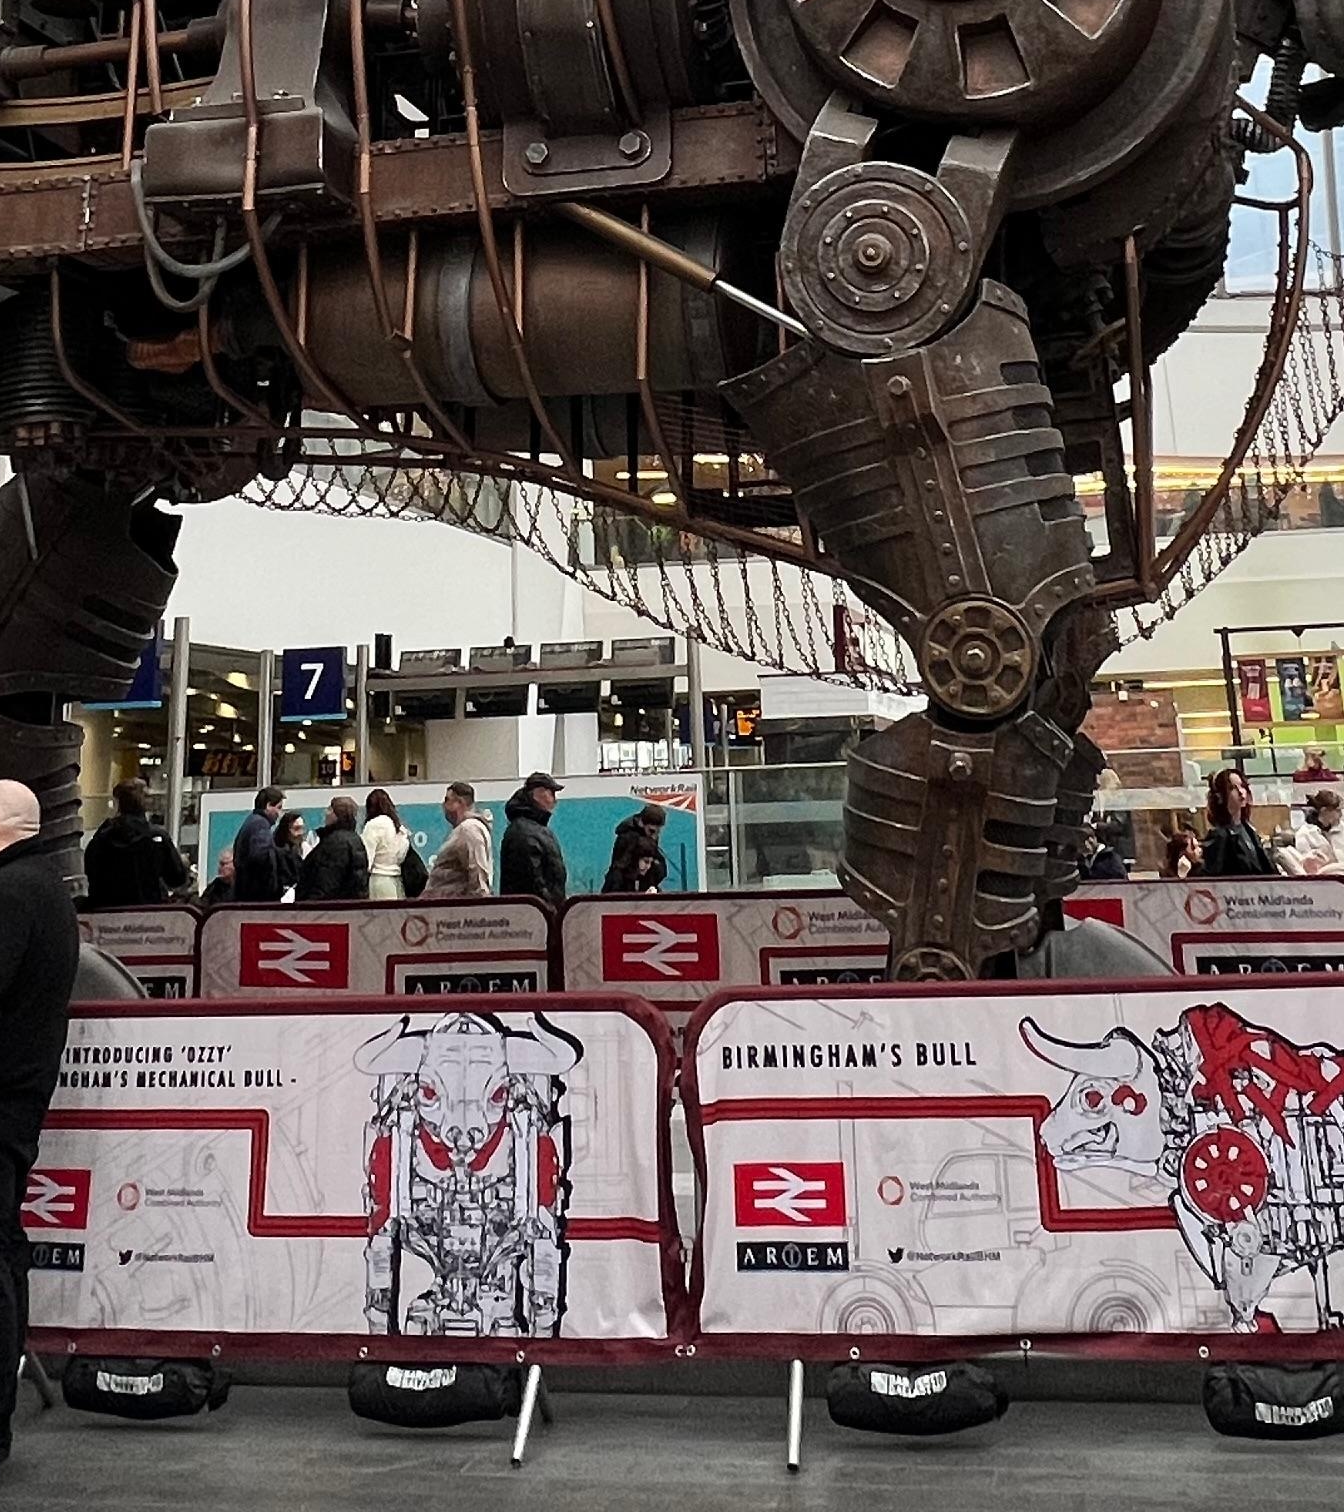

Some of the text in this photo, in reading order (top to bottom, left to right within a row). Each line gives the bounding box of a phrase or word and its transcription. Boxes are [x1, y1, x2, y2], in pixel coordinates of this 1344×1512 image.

[300, 662, 325, 700] 7
[1223, 893, 1315, 907] West Midlands
[1224, 904, 1344, 921] Combined Authority
[64, 1045, 174, 1065] INTRODUCING
[721, 1041, 978, 1070] BIRMINGHAM'S BULL
[59, 1069, 129, 1089] NGHAM'S
[136, 1069, 236, 1088] MECHANICAL
[243, 1068, 284, 1088] BULL
